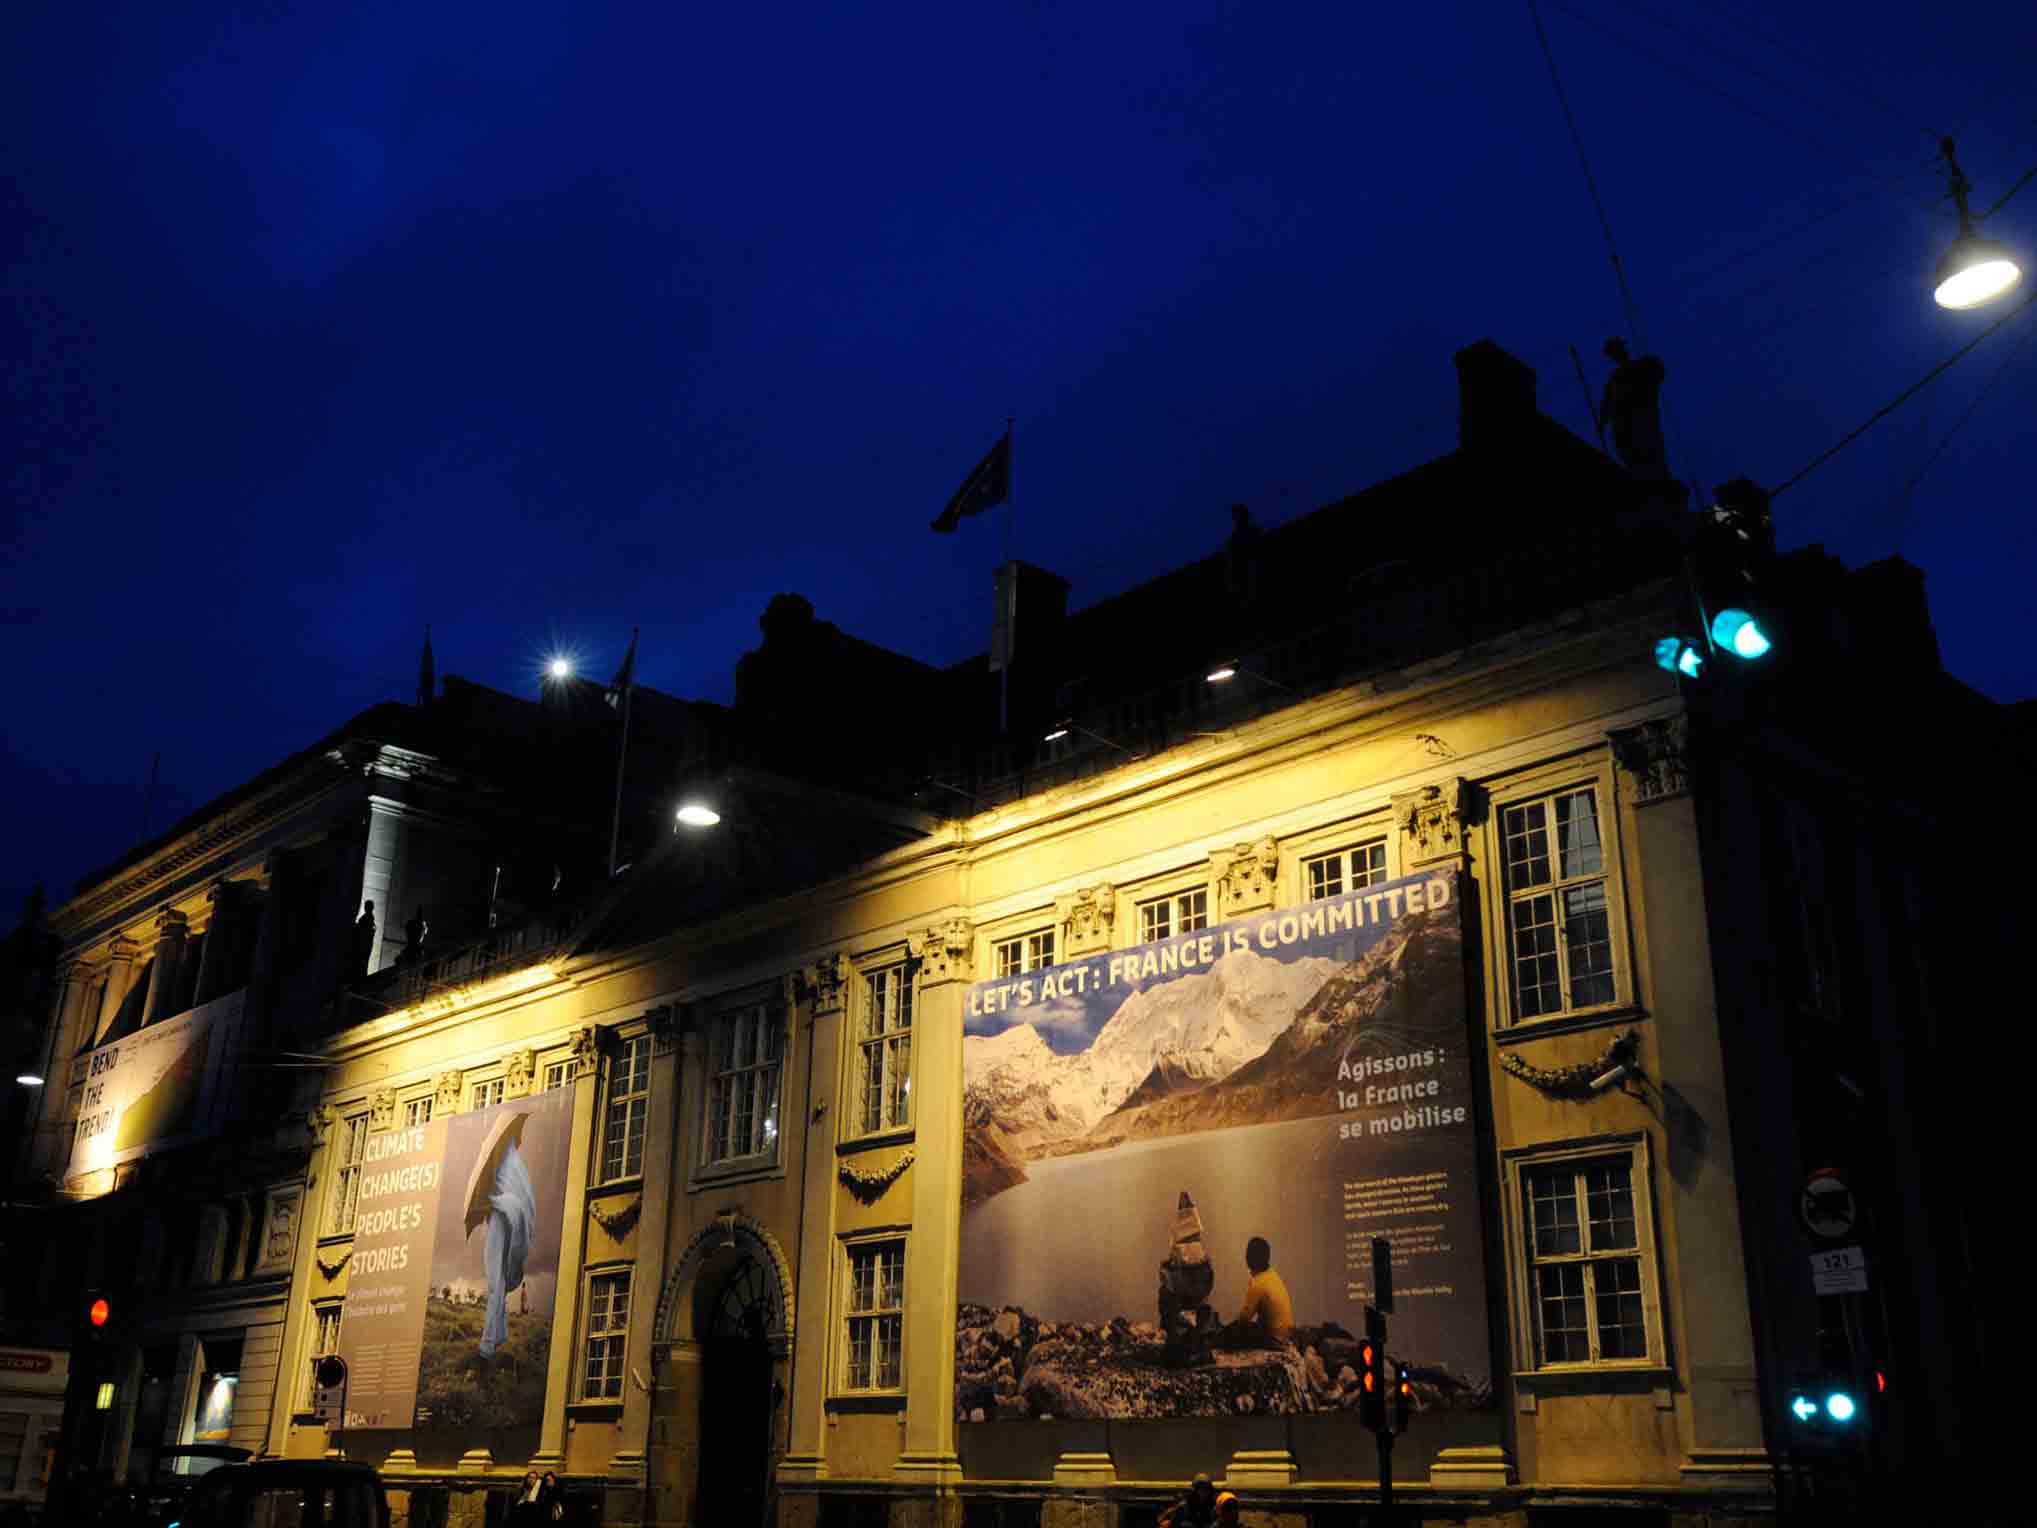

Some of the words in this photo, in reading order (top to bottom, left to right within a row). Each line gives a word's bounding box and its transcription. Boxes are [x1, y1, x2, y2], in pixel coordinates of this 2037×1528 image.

[1109, 934, 1215, 985] FRANCE
[1223, 927, 1252, 952] IS
[1260, 879, 1451, 949] COMMITTED
[91, 1047, 119, 1077] BEND
[83, 1082, 104, 1111] THE
[1337, 1090, 1359, 1110] la
[1365, 1079, 1439, 1105] France
[1339, 1120, 1362, 1139] se
[1369, 1105, 1466, 1135] mobilise
[366, 1126, 425, 1162] CLIMATE
[361, 1161, 440, 1199] CHANGE(S)
[357, 1203, 421, 1238] PEOPLE'S
[351, 1244, 409, 1276] STORIES
